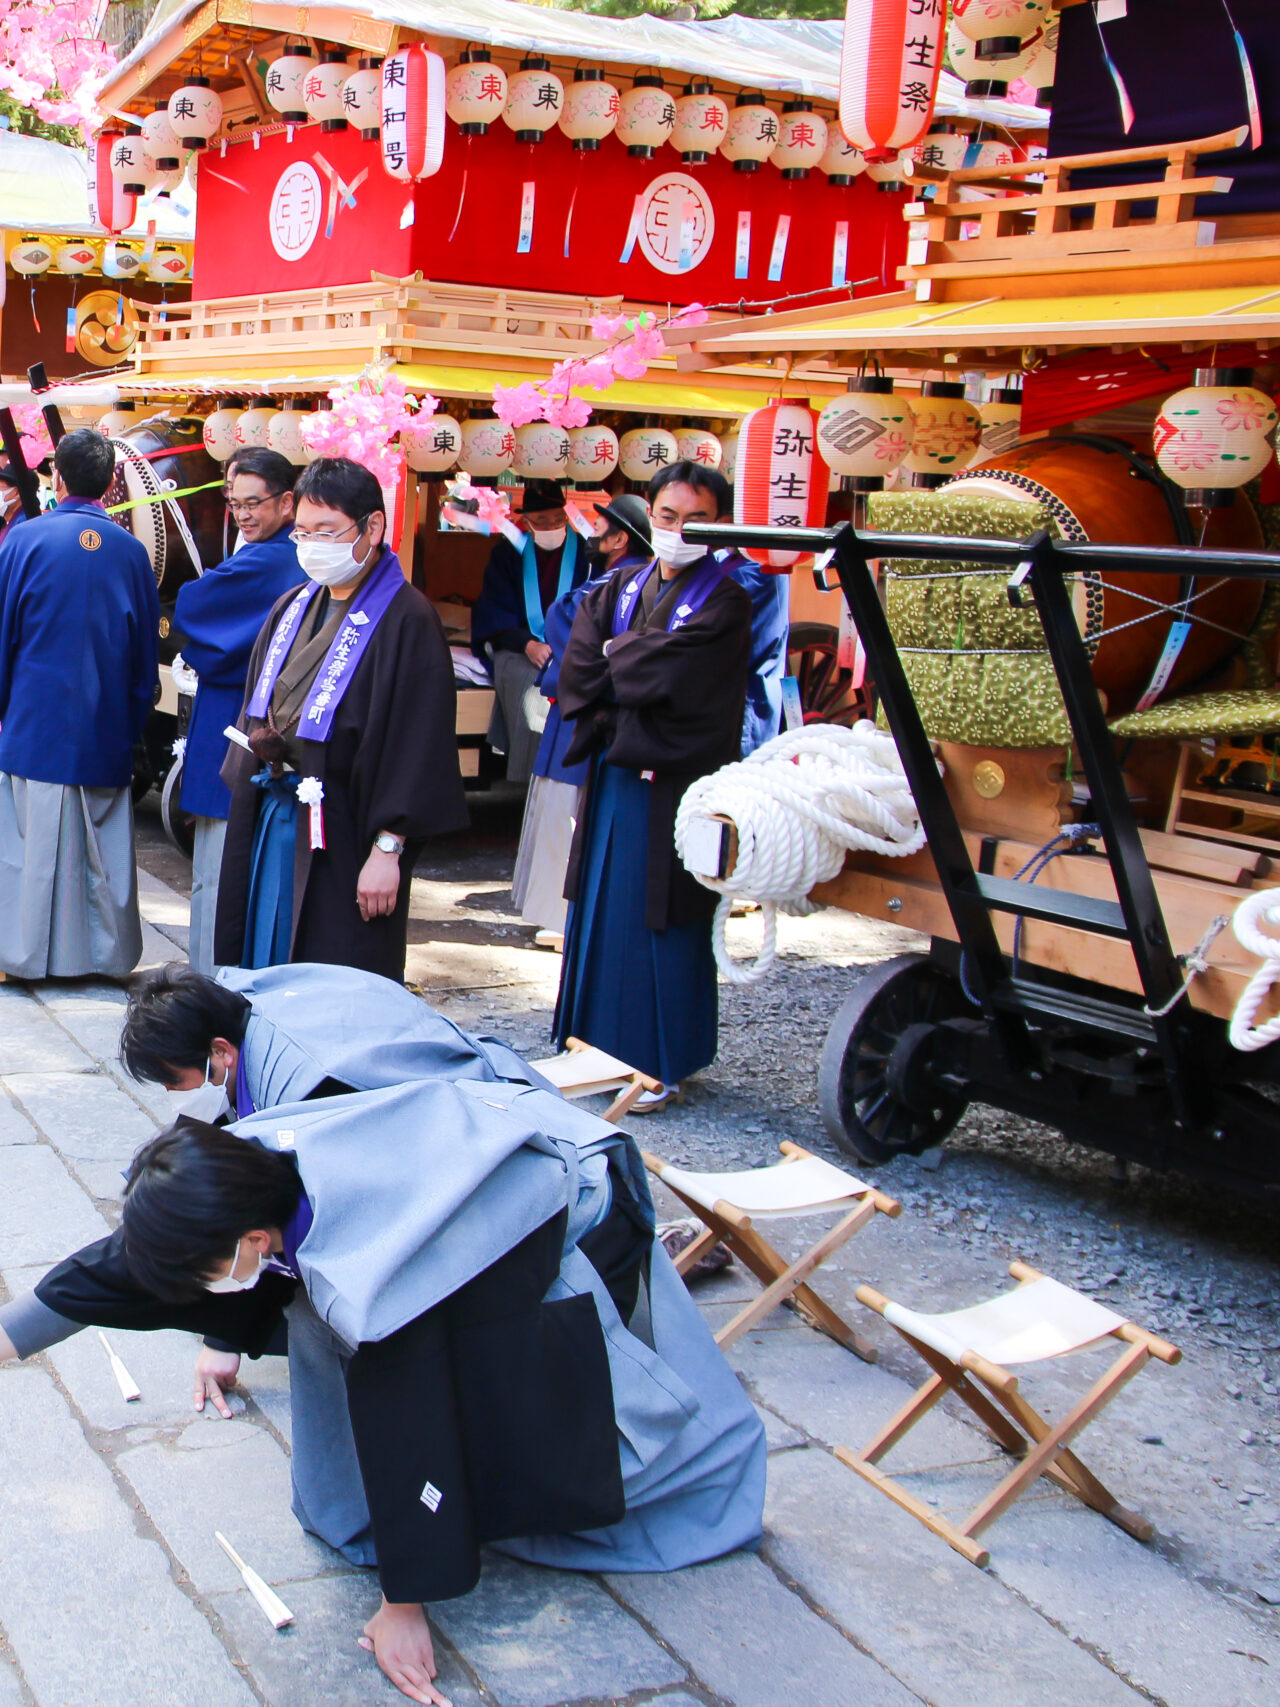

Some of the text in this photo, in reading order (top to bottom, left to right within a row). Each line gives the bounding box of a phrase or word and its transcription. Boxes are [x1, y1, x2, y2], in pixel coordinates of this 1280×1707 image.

[267, 69, 286, 94] 東
[306, 75, 327, 102] 東
[476, 73, 503, 102] 東
[174, 97, 197, 120] 東
[343, 85, 361, 112] 東
[532, 83, 559, 111] 東
[383, 59, 407, 170] 東和号
[658, 104, 676, 129] 東
[699, 105, 724, 132] 東
[756, 117, 778, 143] 東
[787, 123, 816, 149] 東
[114, 146, 135, 168] 東
[923, 145, 946, 167] 東
[429, 430, 456, 454] 東
[496, 432, 516, 458] 東
[555, 438, 570, 464] 東
[590, 439, 615, 465] 東
[642, 442, 669, 466] 東
[693, 442, 716, 464] 東
[308, 626, 361, 725] 弥生祭当番町
